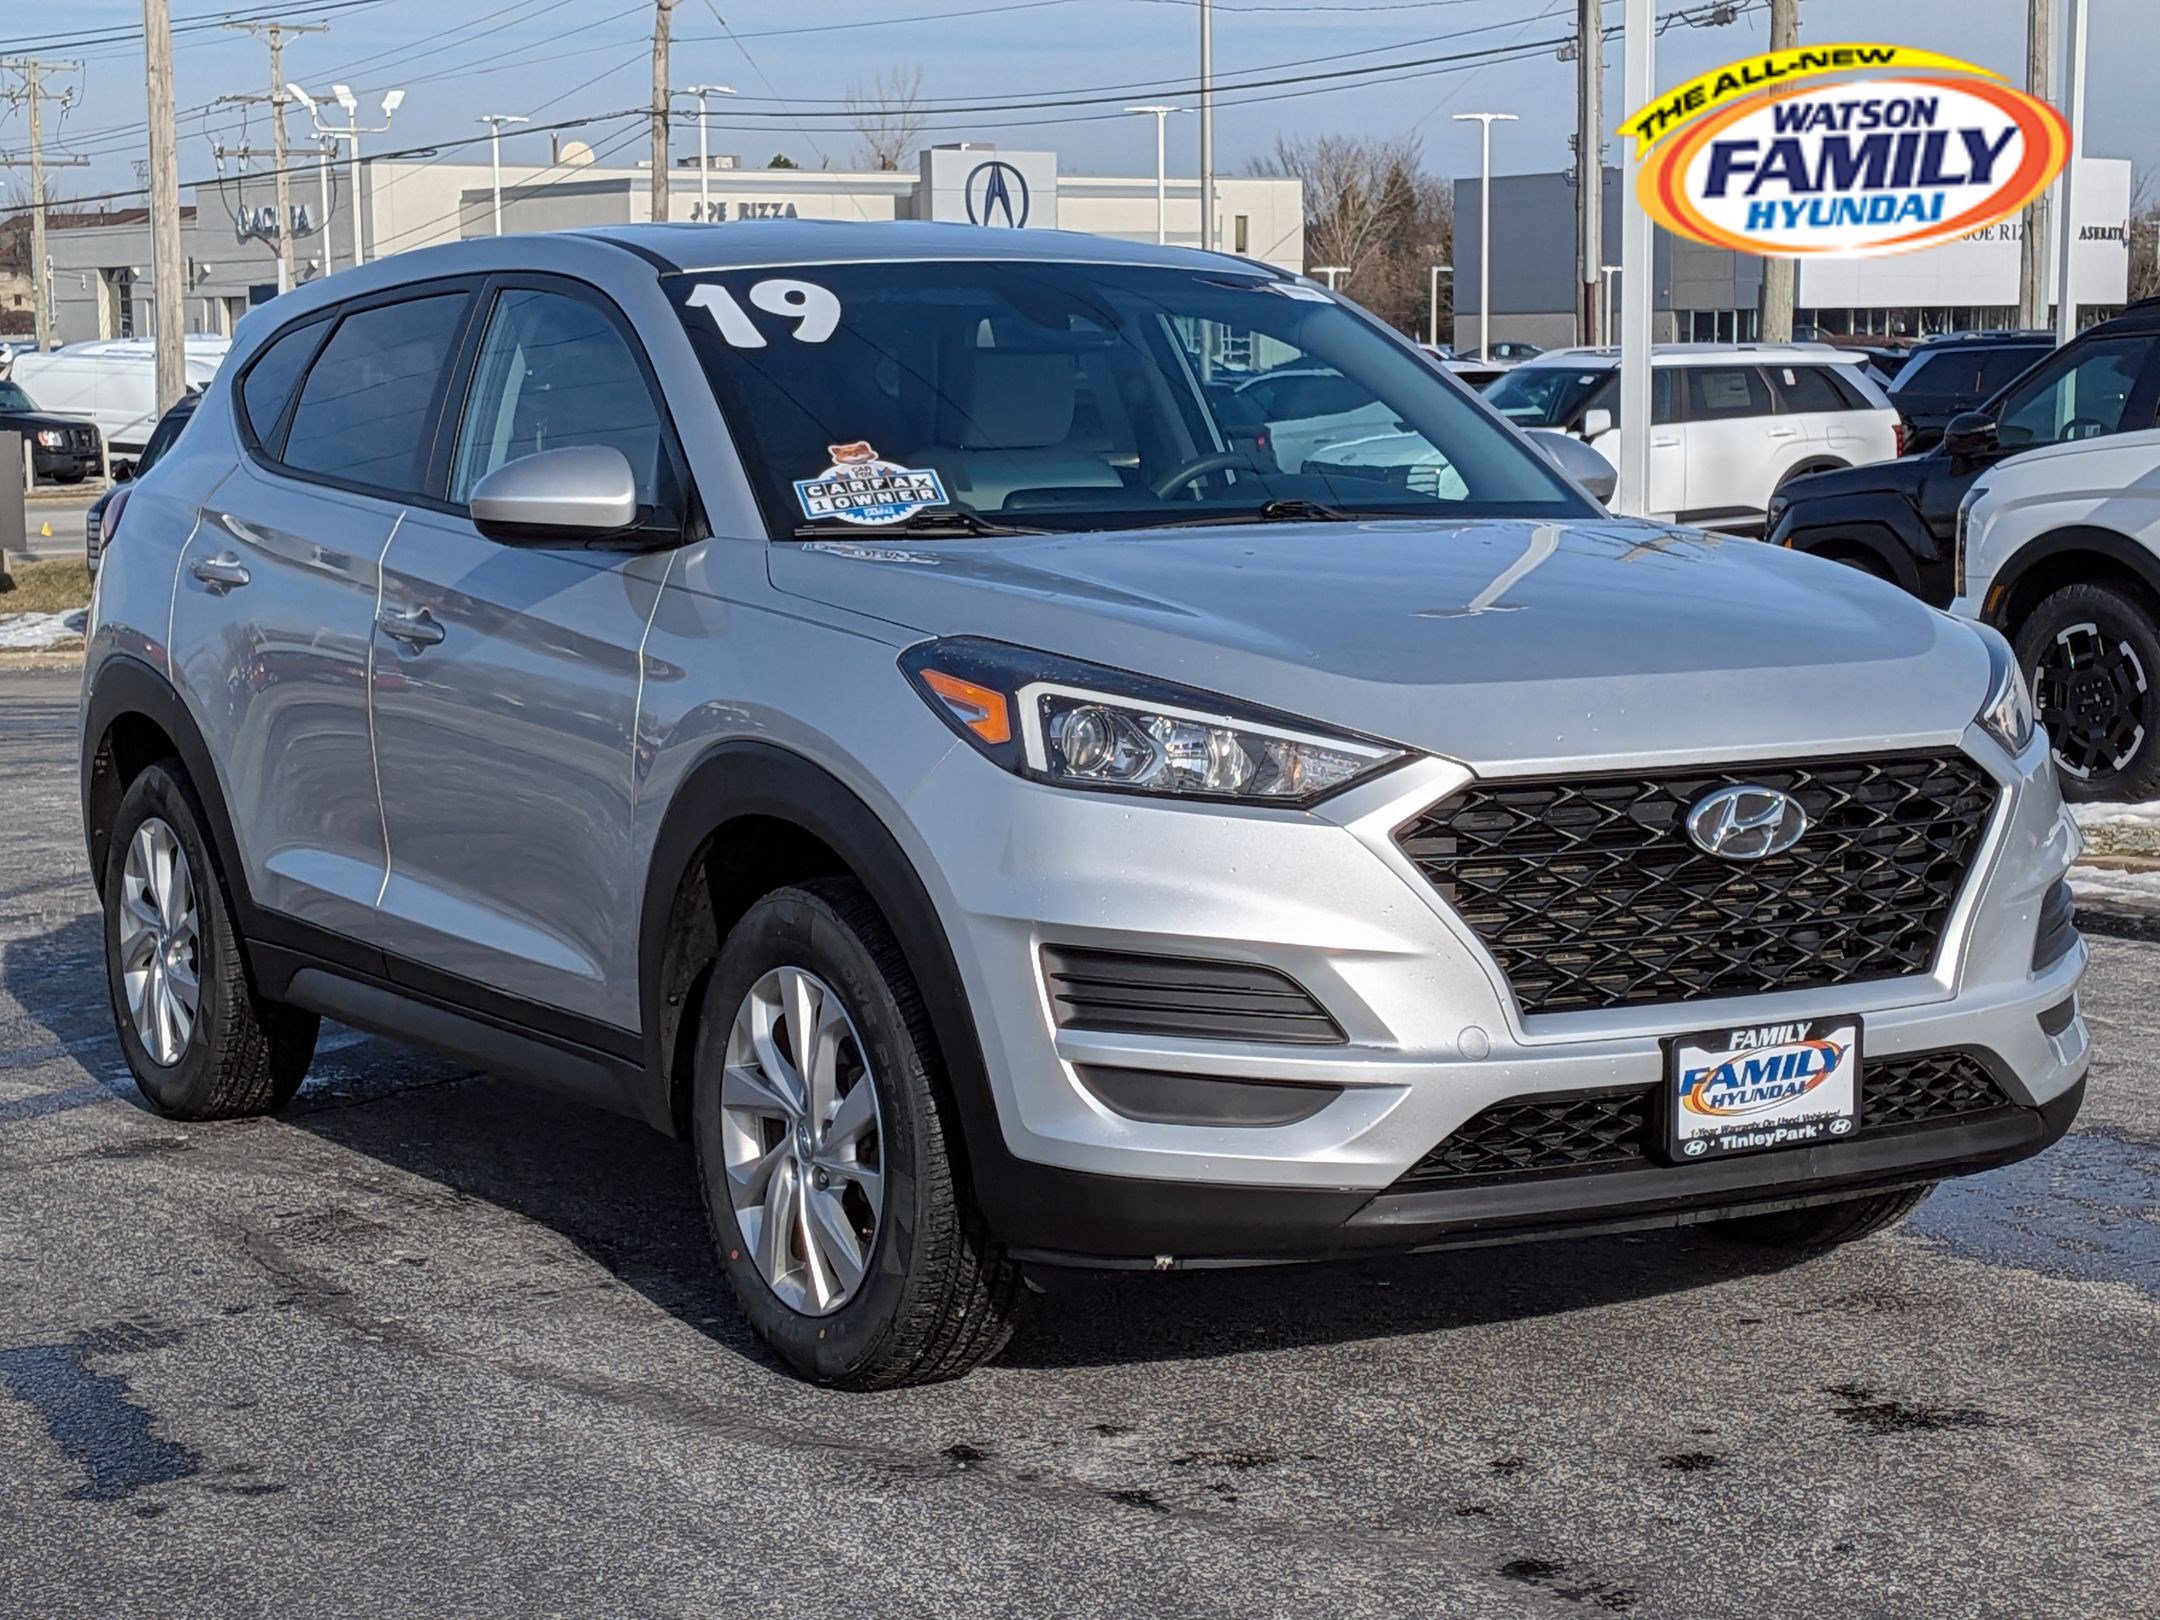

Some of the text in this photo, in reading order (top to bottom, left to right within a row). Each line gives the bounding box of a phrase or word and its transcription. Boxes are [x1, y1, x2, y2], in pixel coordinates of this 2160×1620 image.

[738, 202, 798, 221] RIZZA
[685, 279, 841, 348] 19
[807, 477, 930, 497] CARFAX
[1729, 1022, 1812, 1051] FAMILY
[1679, 1044, 1852, 1097] FAMILY
[1710, 1081, 1808, 1109] HYUNDAI
